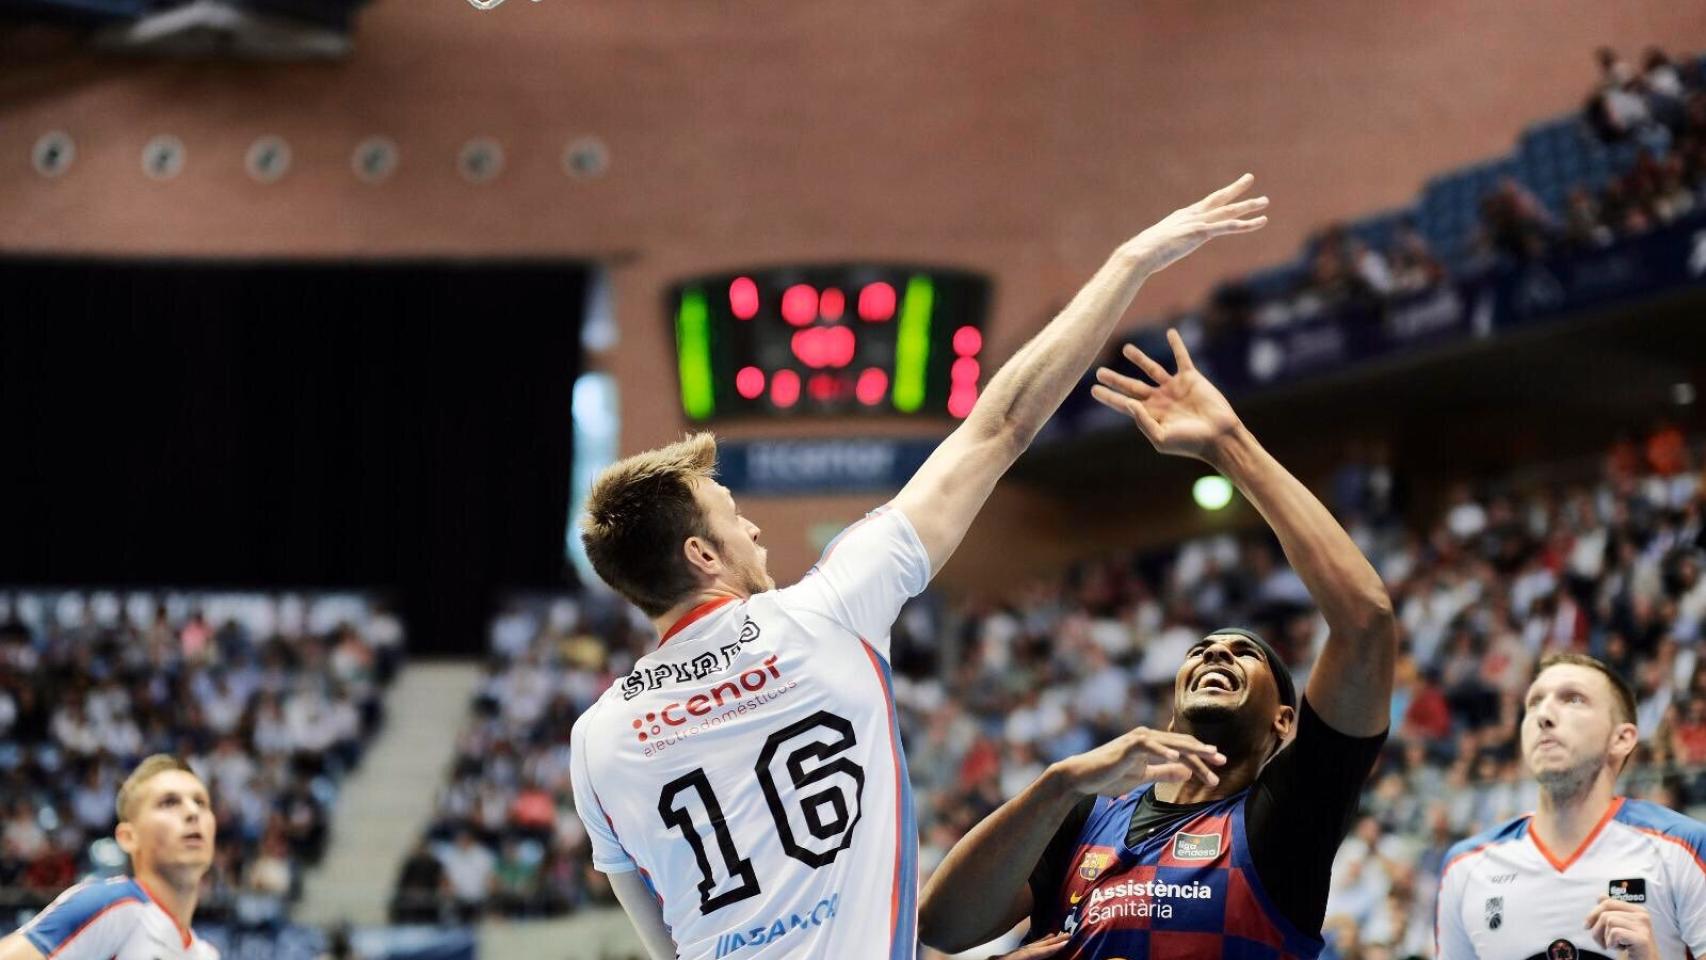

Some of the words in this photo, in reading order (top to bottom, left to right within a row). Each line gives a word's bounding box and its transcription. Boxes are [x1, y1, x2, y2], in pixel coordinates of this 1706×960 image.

[660, 654, 781, 727] cenor
[658, 710, 865, 915] 16
[1088, 897, 1173, 925] Sanitària
[1090, 879, 1212, 907] Assistència
